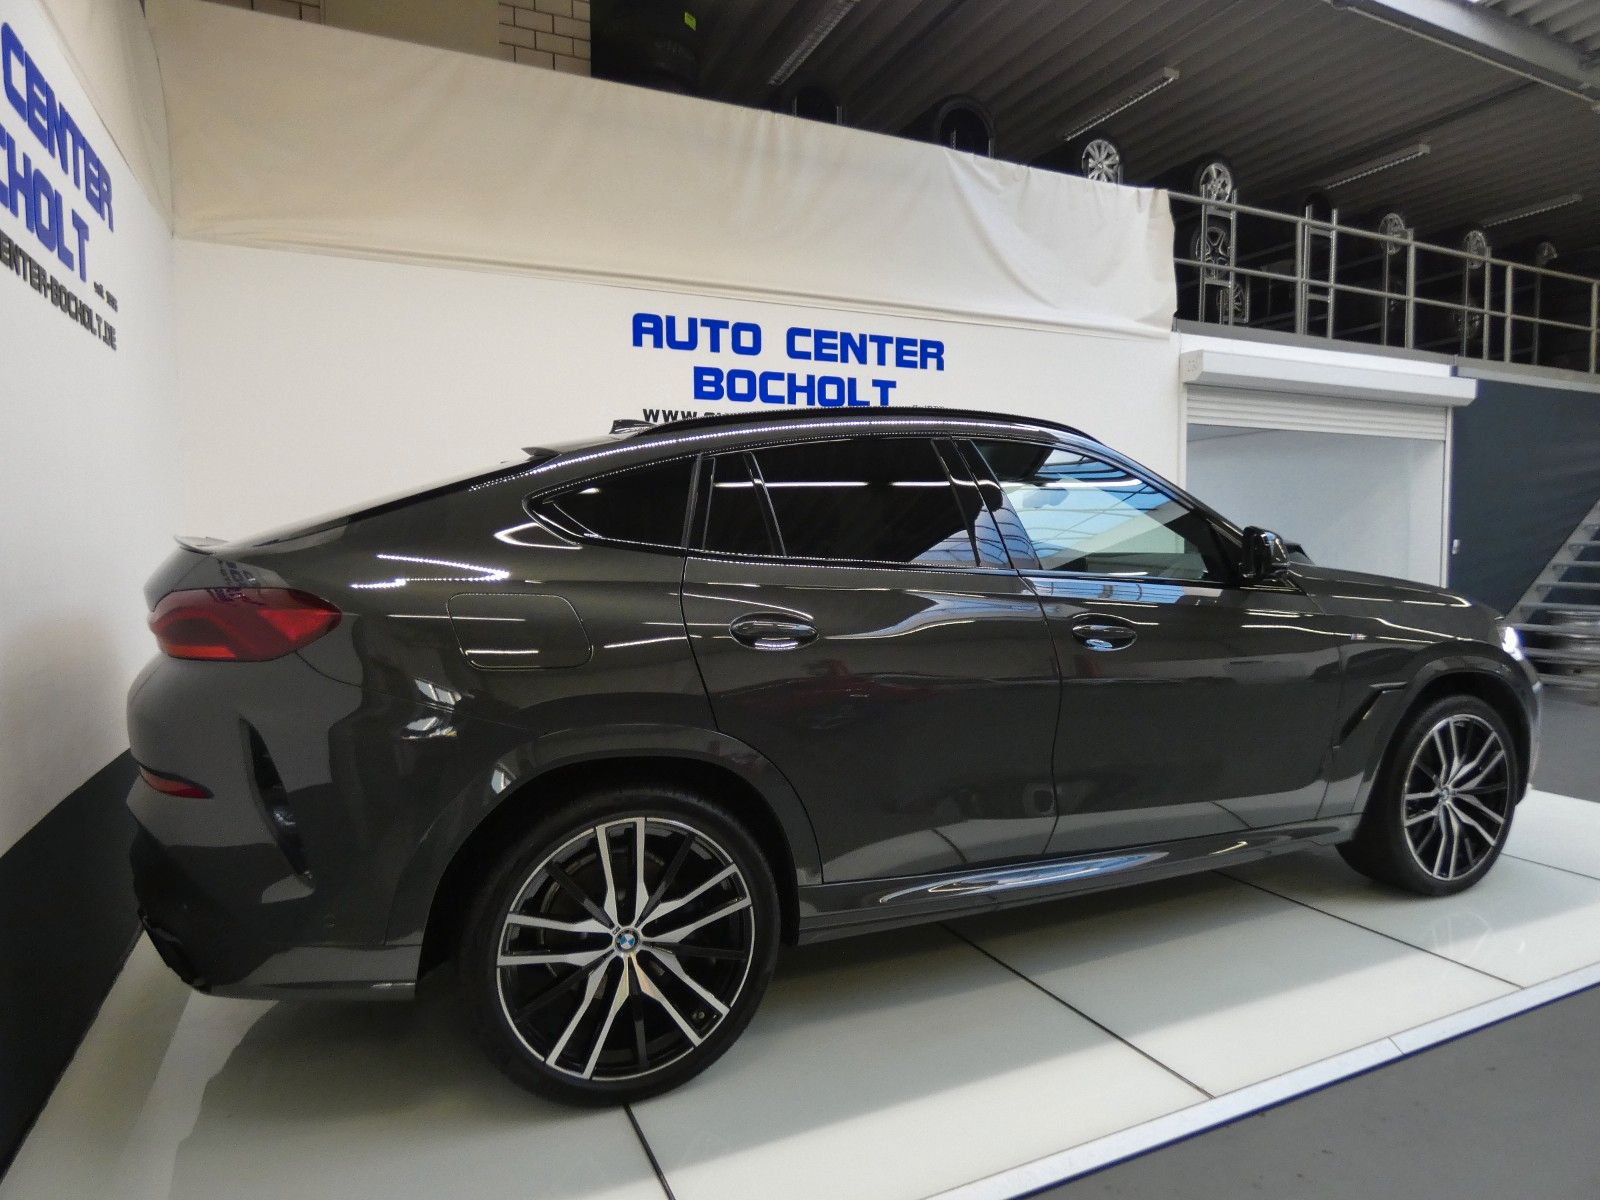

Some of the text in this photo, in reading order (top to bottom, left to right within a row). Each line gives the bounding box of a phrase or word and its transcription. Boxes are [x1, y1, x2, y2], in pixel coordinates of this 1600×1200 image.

[1, 21, 114, 233] CENTER
[632, 312, 945, 371] AUTO CENTER
[693, 365, 897, 408] BOCHOLT
